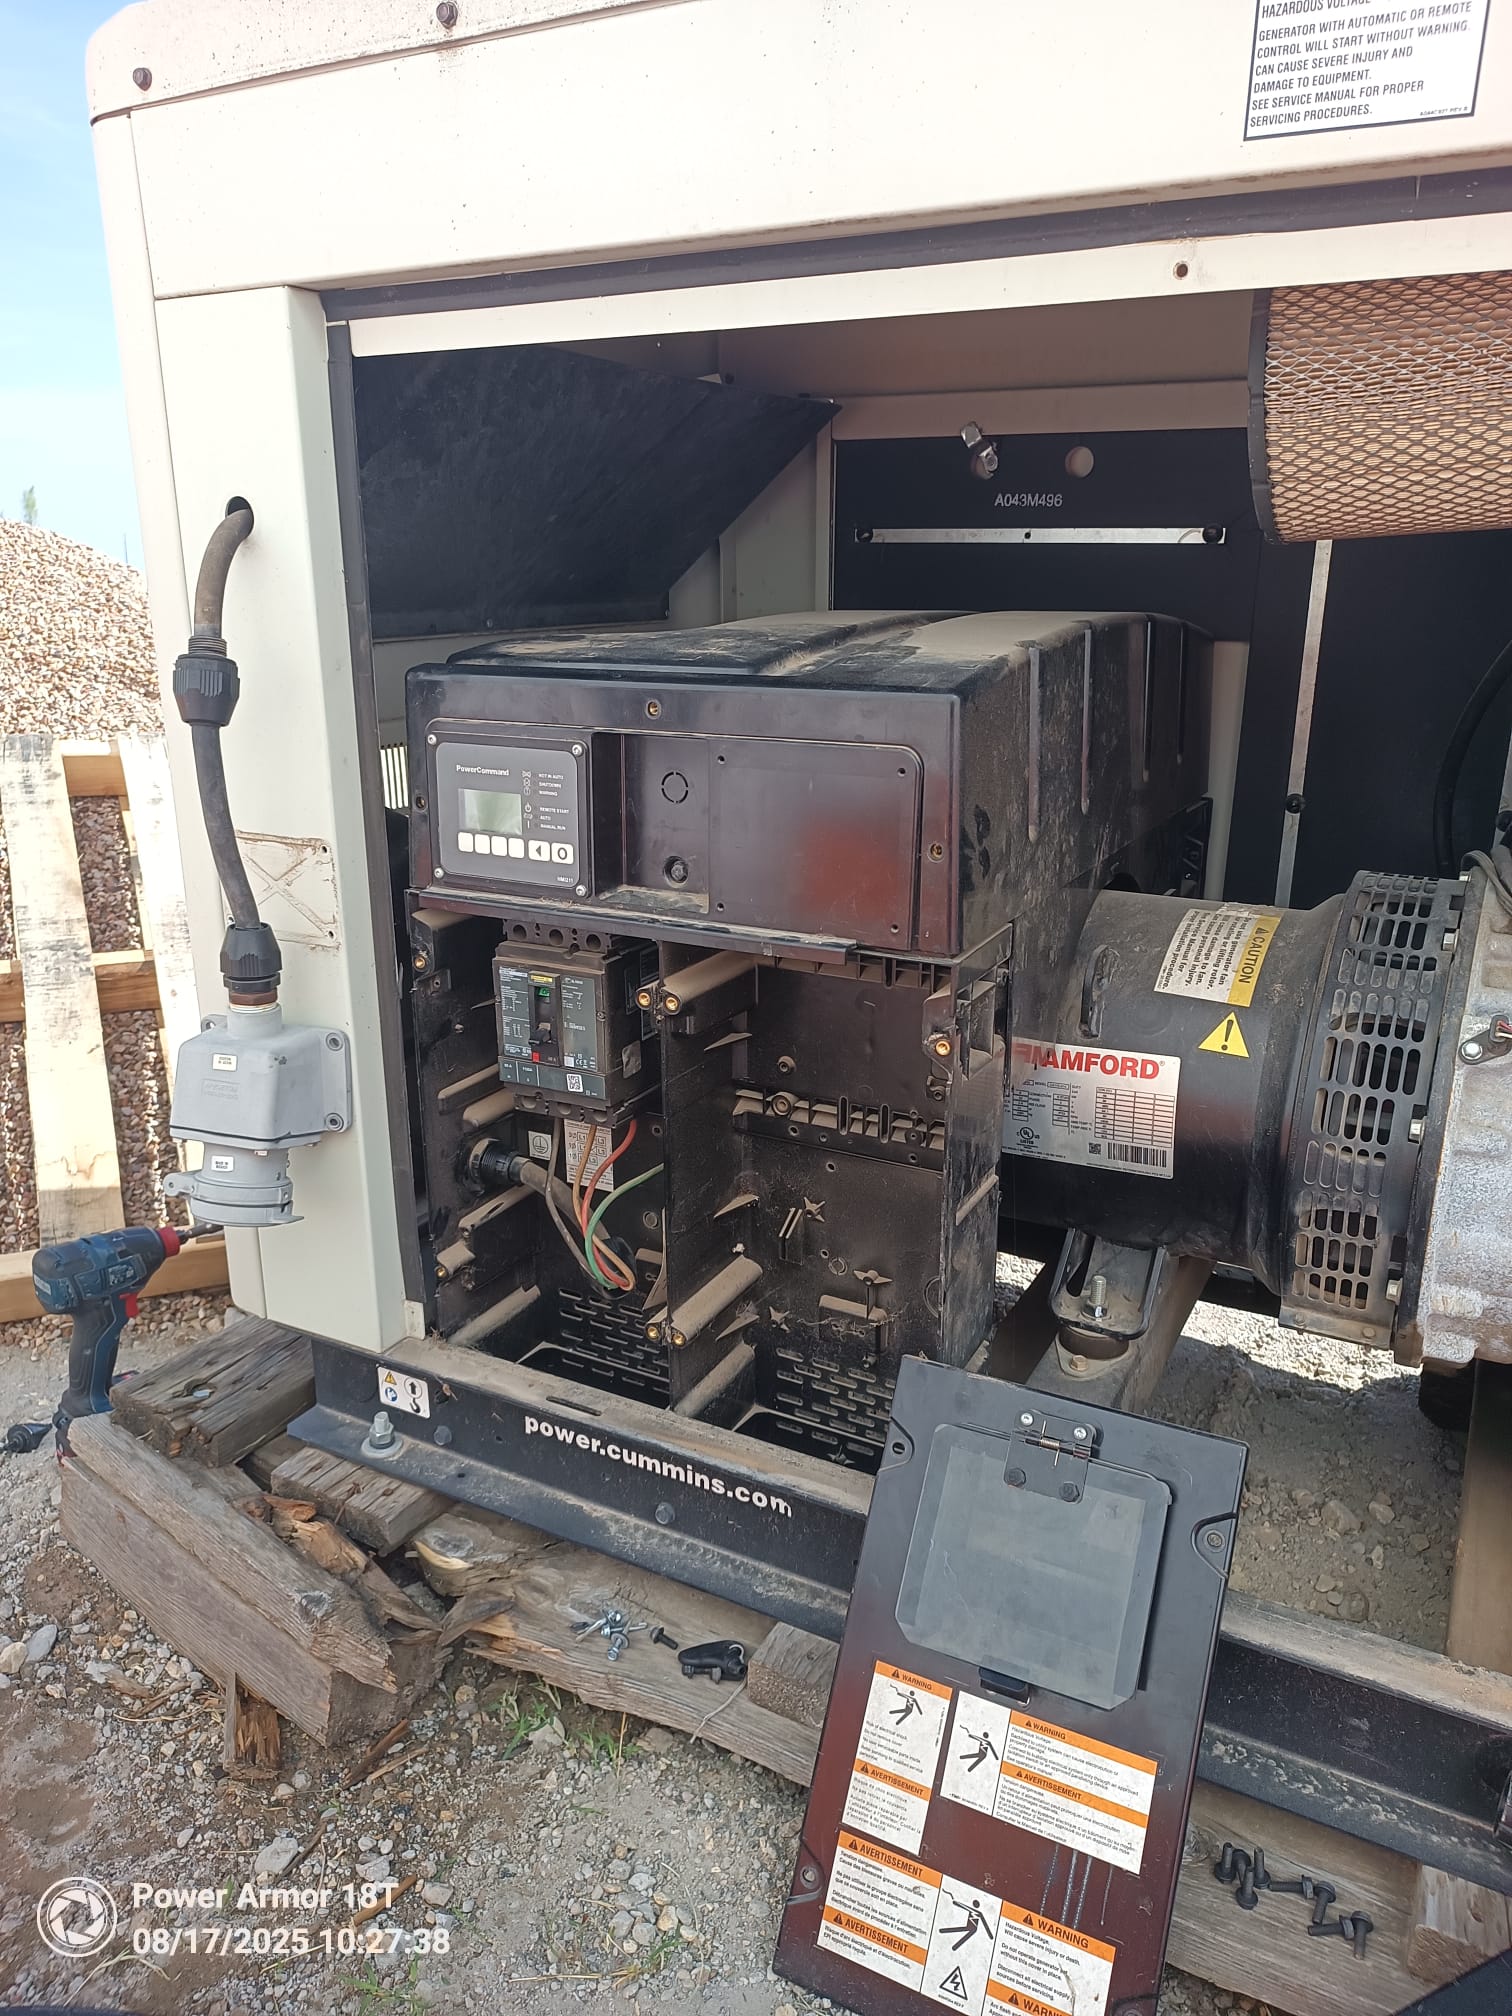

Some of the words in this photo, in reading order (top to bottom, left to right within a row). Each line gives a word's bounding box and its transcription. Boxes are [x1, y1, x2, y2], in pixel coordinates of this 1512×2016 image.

[1258, 23, 1315, 41] GENERATOR
[1318, 19, 1345, 33] WITH
[1347, 10, 1406, 29] AUTOMATIC
[1409, 8, 1424, 20] OR
[1427, 0, 1472, 17] REMOTE
[1261, 0, 1323, 19] HAZARDOUS
[1256, 43, 1301, 58] CONTROL
[1304, 39, 1329, 52] WILL
[1332, 34, 1363, 48] START
[1365, 27, 1413, 44] WITHOUT
[1416, 19, 1471, 37] WARNING.
[1255, 63, 1274, 76] CAN
[1276, 59, 1308, 73] CAUSE
[1311, 54, 1349, 68] SEVERE
[1351, 49, 1388, 63] INJURY
[1391, 45, 1413, 58] AND
[1253, 78, 1294, 93] DAMAGE
[1296, 76, 1309, 88] TO
[1311, 68, 1372, 86] EQUIPMENT.
[1251, 98, 1269, 110] SEE
[1271, 93, 1312, 108] SERVICE
[1314, 88, 1356, 103] MANUAL
[1359, 85, 1379, 97] FOR
[1382, 80, 1424, 95] PROPER
[1249, 111, 1300, 127] SERVICING
[1303, 103, 1373, 121] PROCEDURES.
[994, 493, 1063, 507] A043M496
[456, 764, 509, 775] PowerCommand
[1181, 938, 1196, 960] Manual
[1196, 935, 1208, 963] personal
[1204, 936, 1218, 960] damage
[1212, 948, 1226, 967] lifting
[1222, 940, 1238, 971] generator
[1238, 936, 1265, 983] CAUTION
[1162, 953, 1178, 989] procedure.
[1177, 962, 1187, 972] for
[1184, 963, 1199, 986] injury.
[1195, 971, 1206, 984] fan.
[1206, 969, 1217, 989] rotor.
[1218, 973, 1228, 985] fan
[524, 1415, 793, 1518] power.cummins.com
[902, 1674, 931, 1690] WARNING
[1033, 1722, 1065, 1739] WARNING
[870, 1769, 923, 1794] AVERTISSEMENT
[1023, 1773, 1081, 1799] AVERTISSEMENT
[859, 1844, 922, 1876] AVERTISSEMENT
[844, 1918, 907, 1952] AVERTISSEMENT
[1038, 1919, 1088, 1948] WARNING
[1044, 1946, 1058, 1957] injury
[1018, 1957, 1027, 1965] this
[1028, 1962, 1041, 1971] cover
[1036, 1958, 1059, 1971] generator
